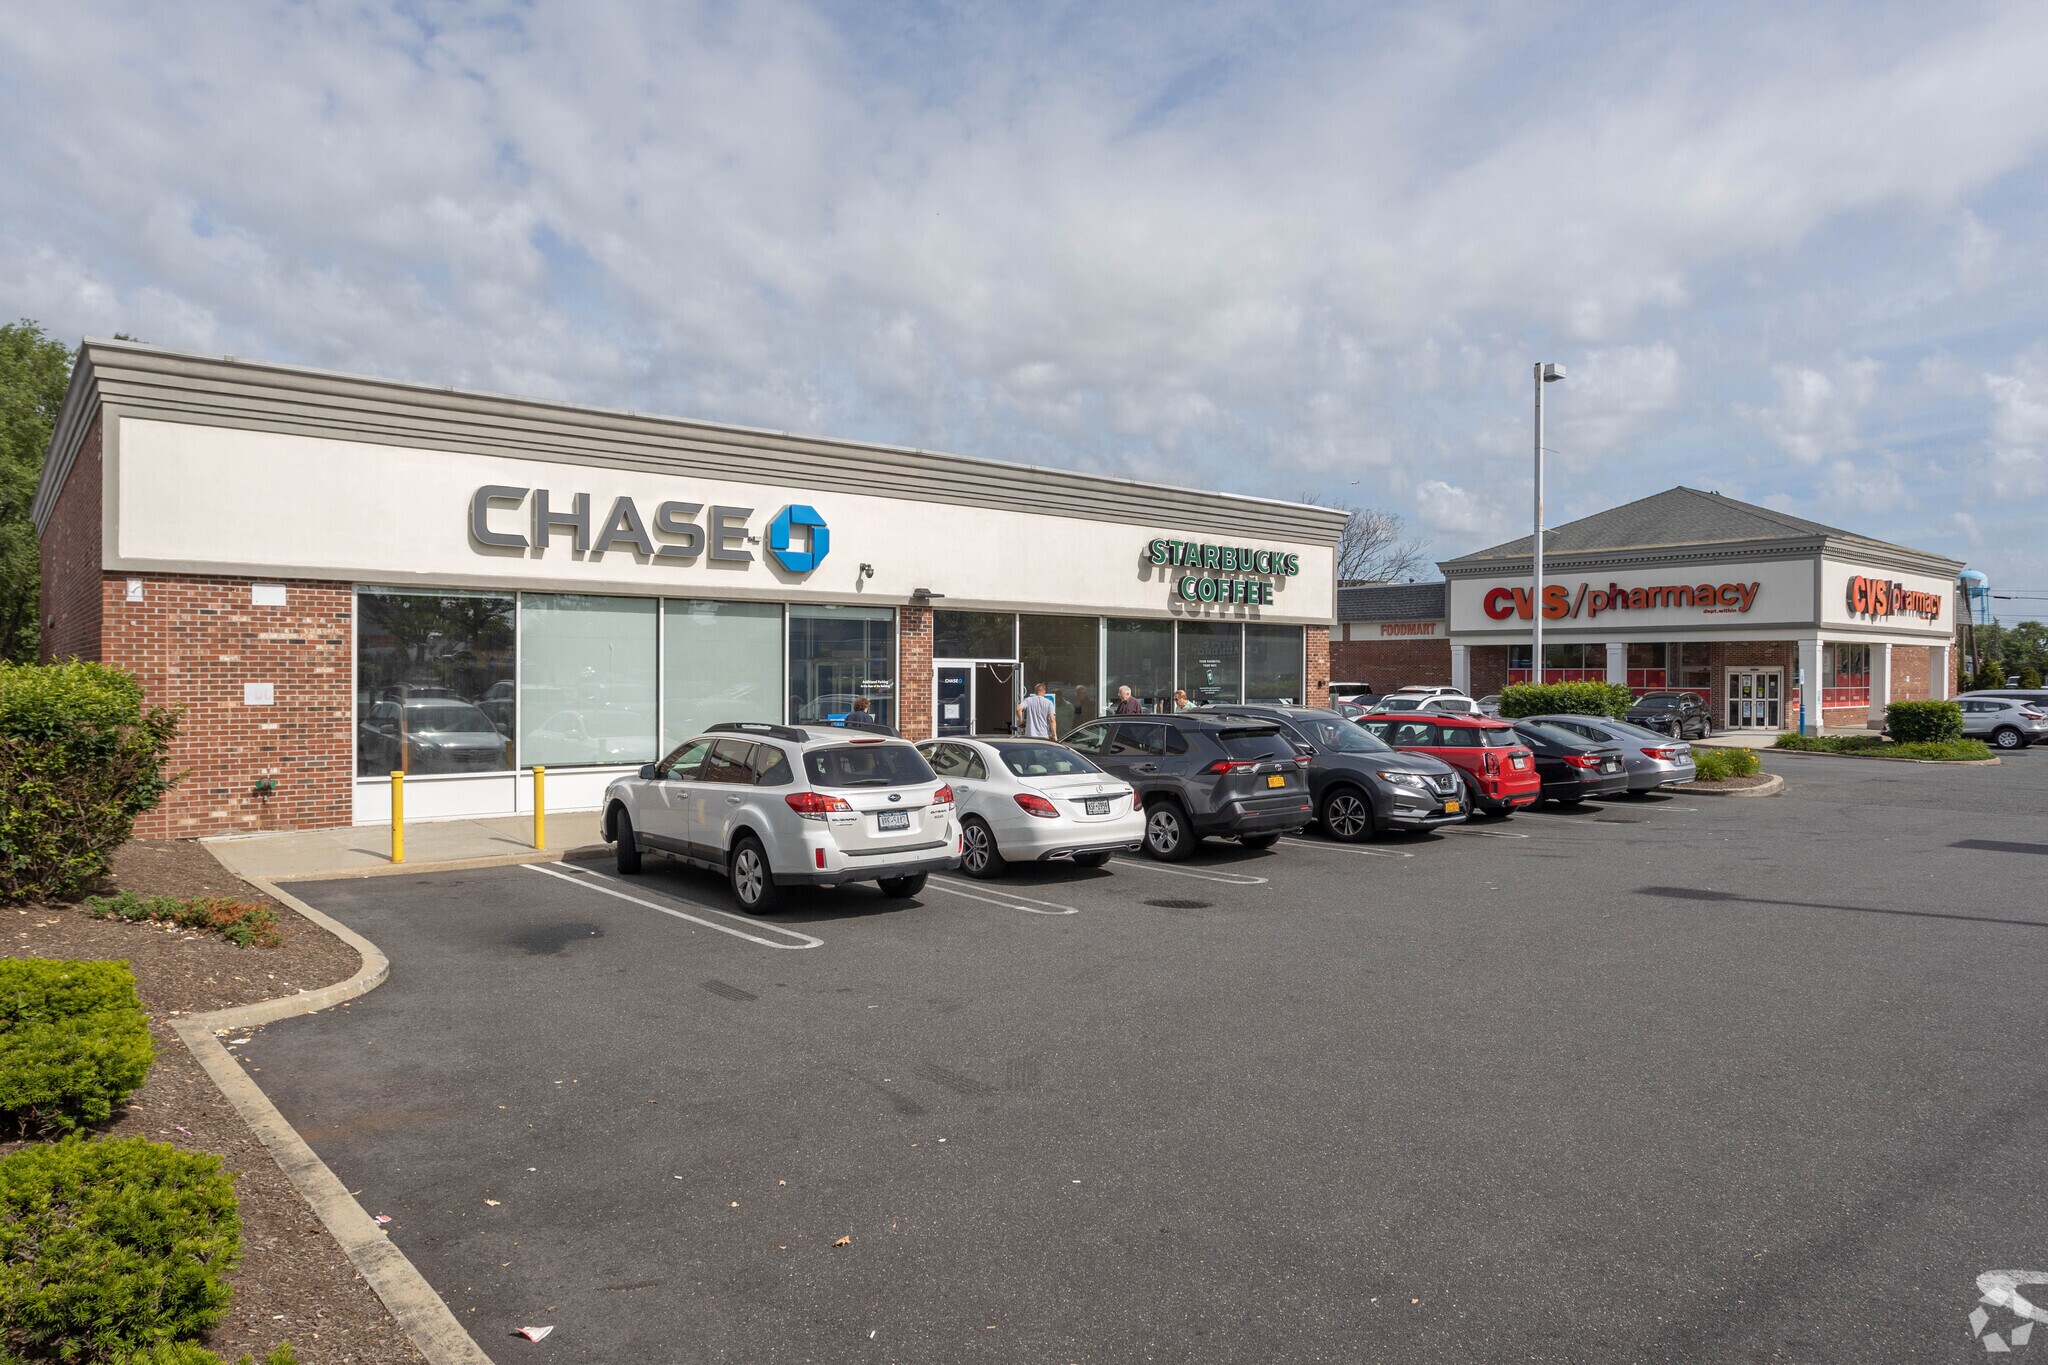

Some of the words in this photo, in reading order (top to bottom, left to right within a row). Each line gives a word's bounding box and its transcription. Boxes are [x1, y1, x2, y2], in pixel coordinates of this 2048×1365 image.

[472, 484, 755, 562] CHASE
[1150, 538, 1300, 577] STARBUCKS
[1179, 575, 1274, 606] COFFEE
[1380, 622, 1437, 637] FOODMART
